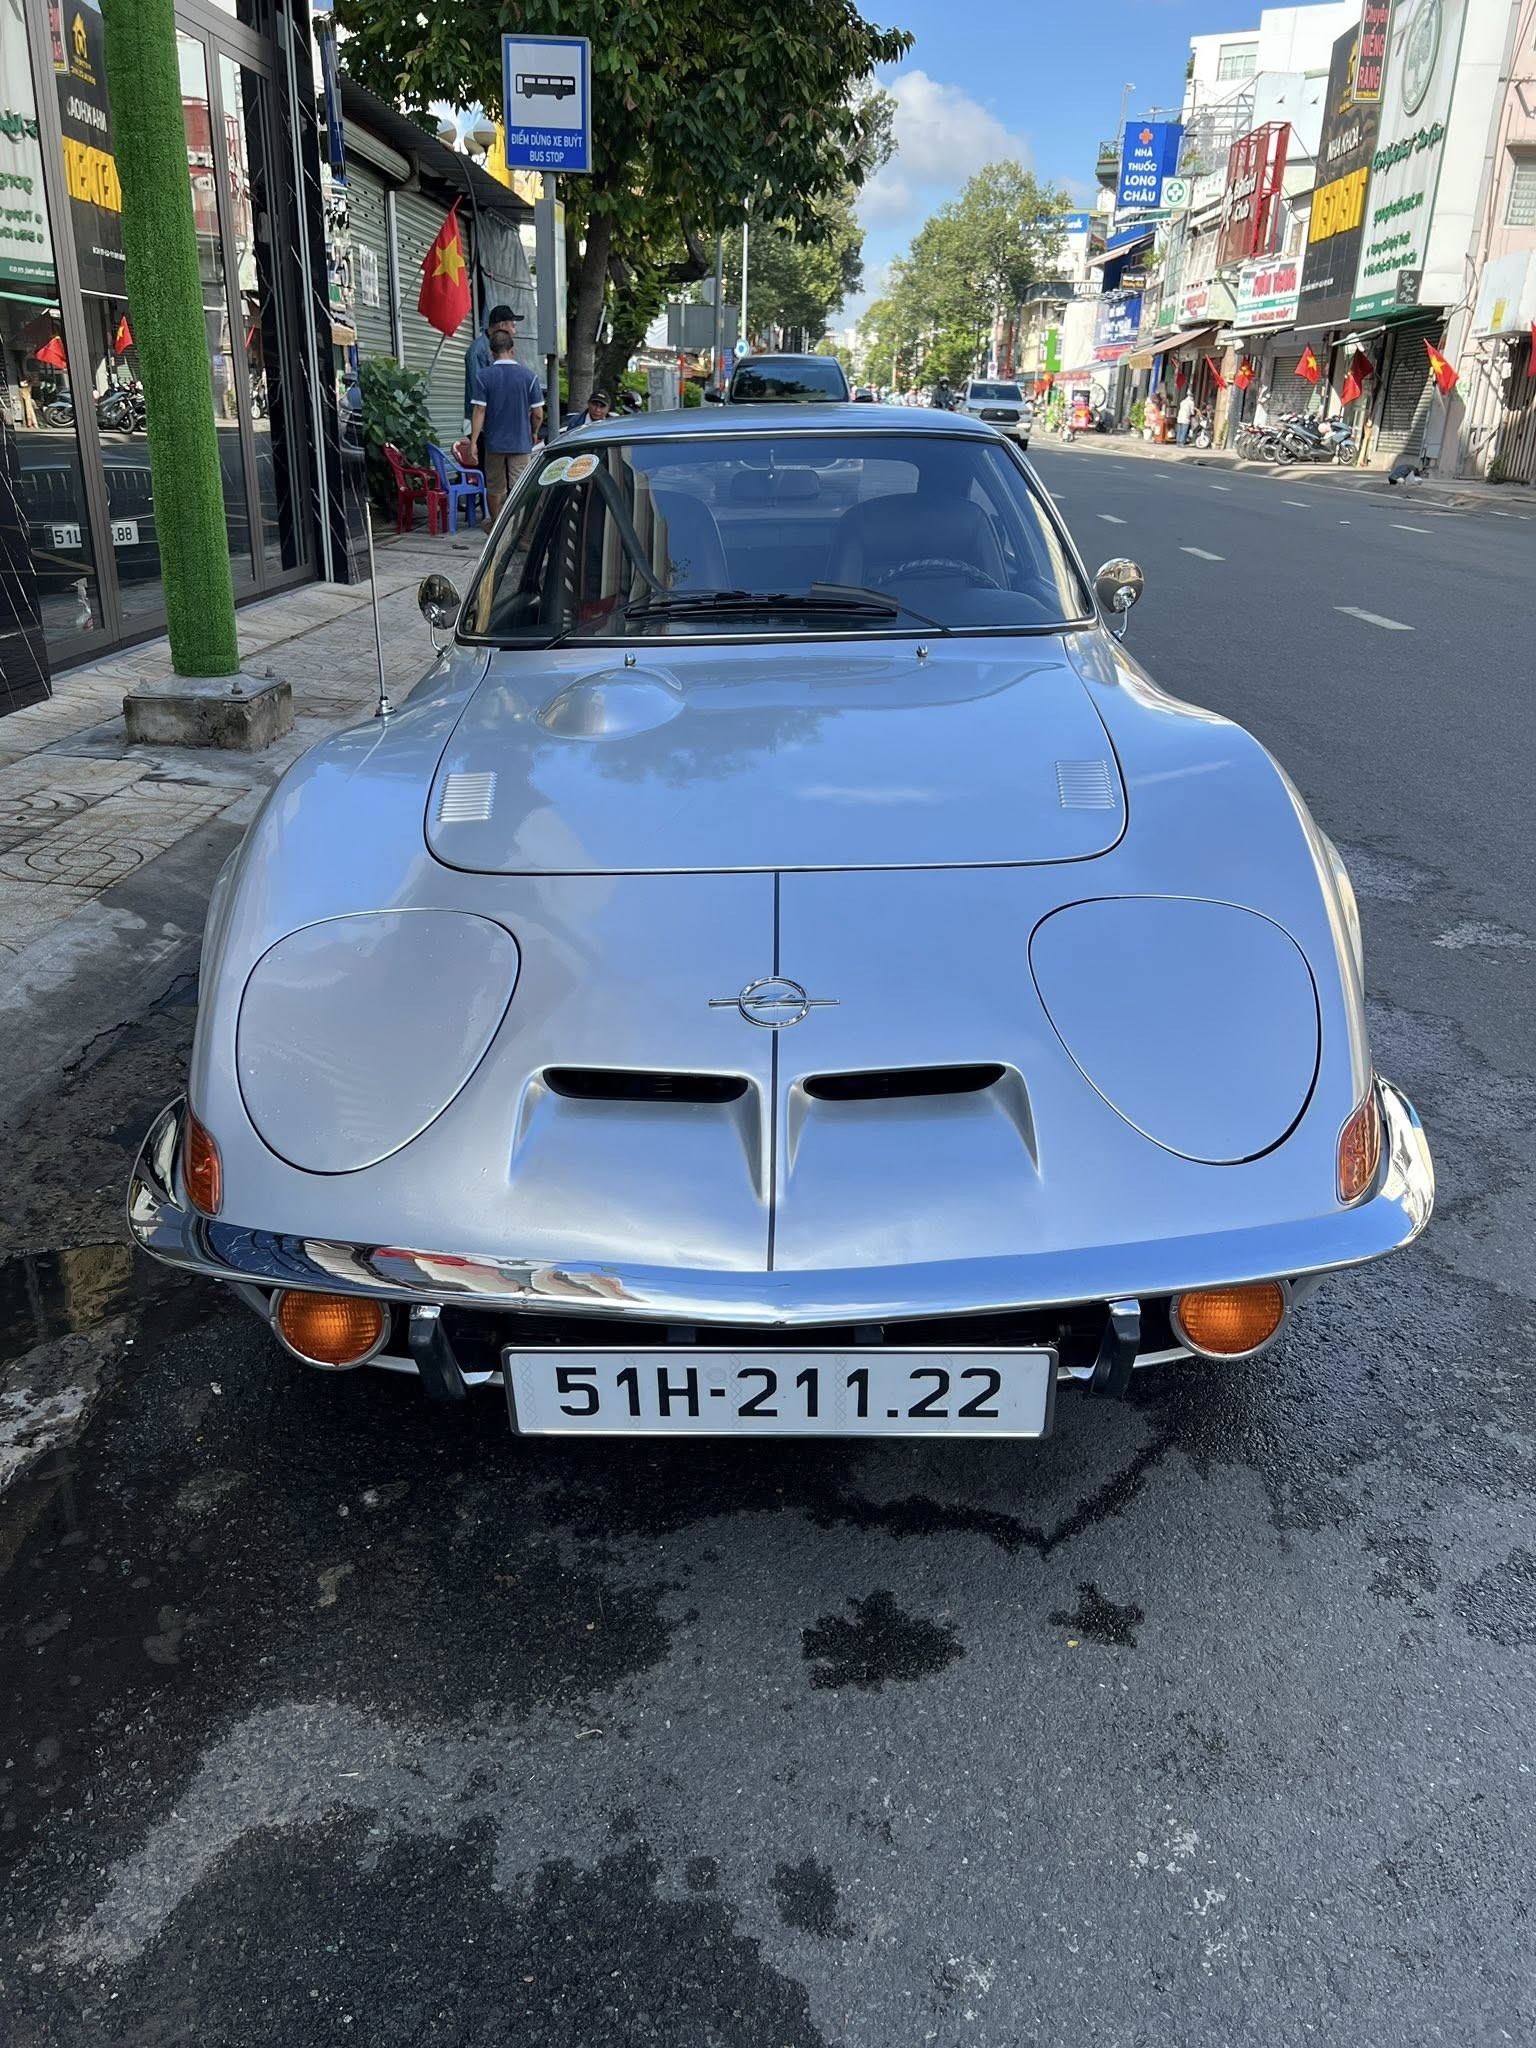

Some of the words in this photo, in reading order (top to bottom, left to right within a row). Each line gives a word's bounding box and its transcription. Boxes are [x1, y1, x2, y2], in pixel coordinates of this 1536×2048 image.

[511, 129, 529, 145] ĐIỂM
[530, 132, 551, 146] DỪNG
[553, 135, 562, 147] XE
[563, 133, 582, 148] BUÝT
[529, 150, 544, 162] BUS
[545, 151, 564, 163] STOP
[1134, 147, 1153, 157] NHÀ
[1128, 160, 1157, 171] THUỐC
[1125, 175, 1156, 186] LONG
[1123, 188, 1156, 201] CHÂU
[54, 530, 82, 544] 51L
[556, 1367, 1001, 1419] 51H-211.22
